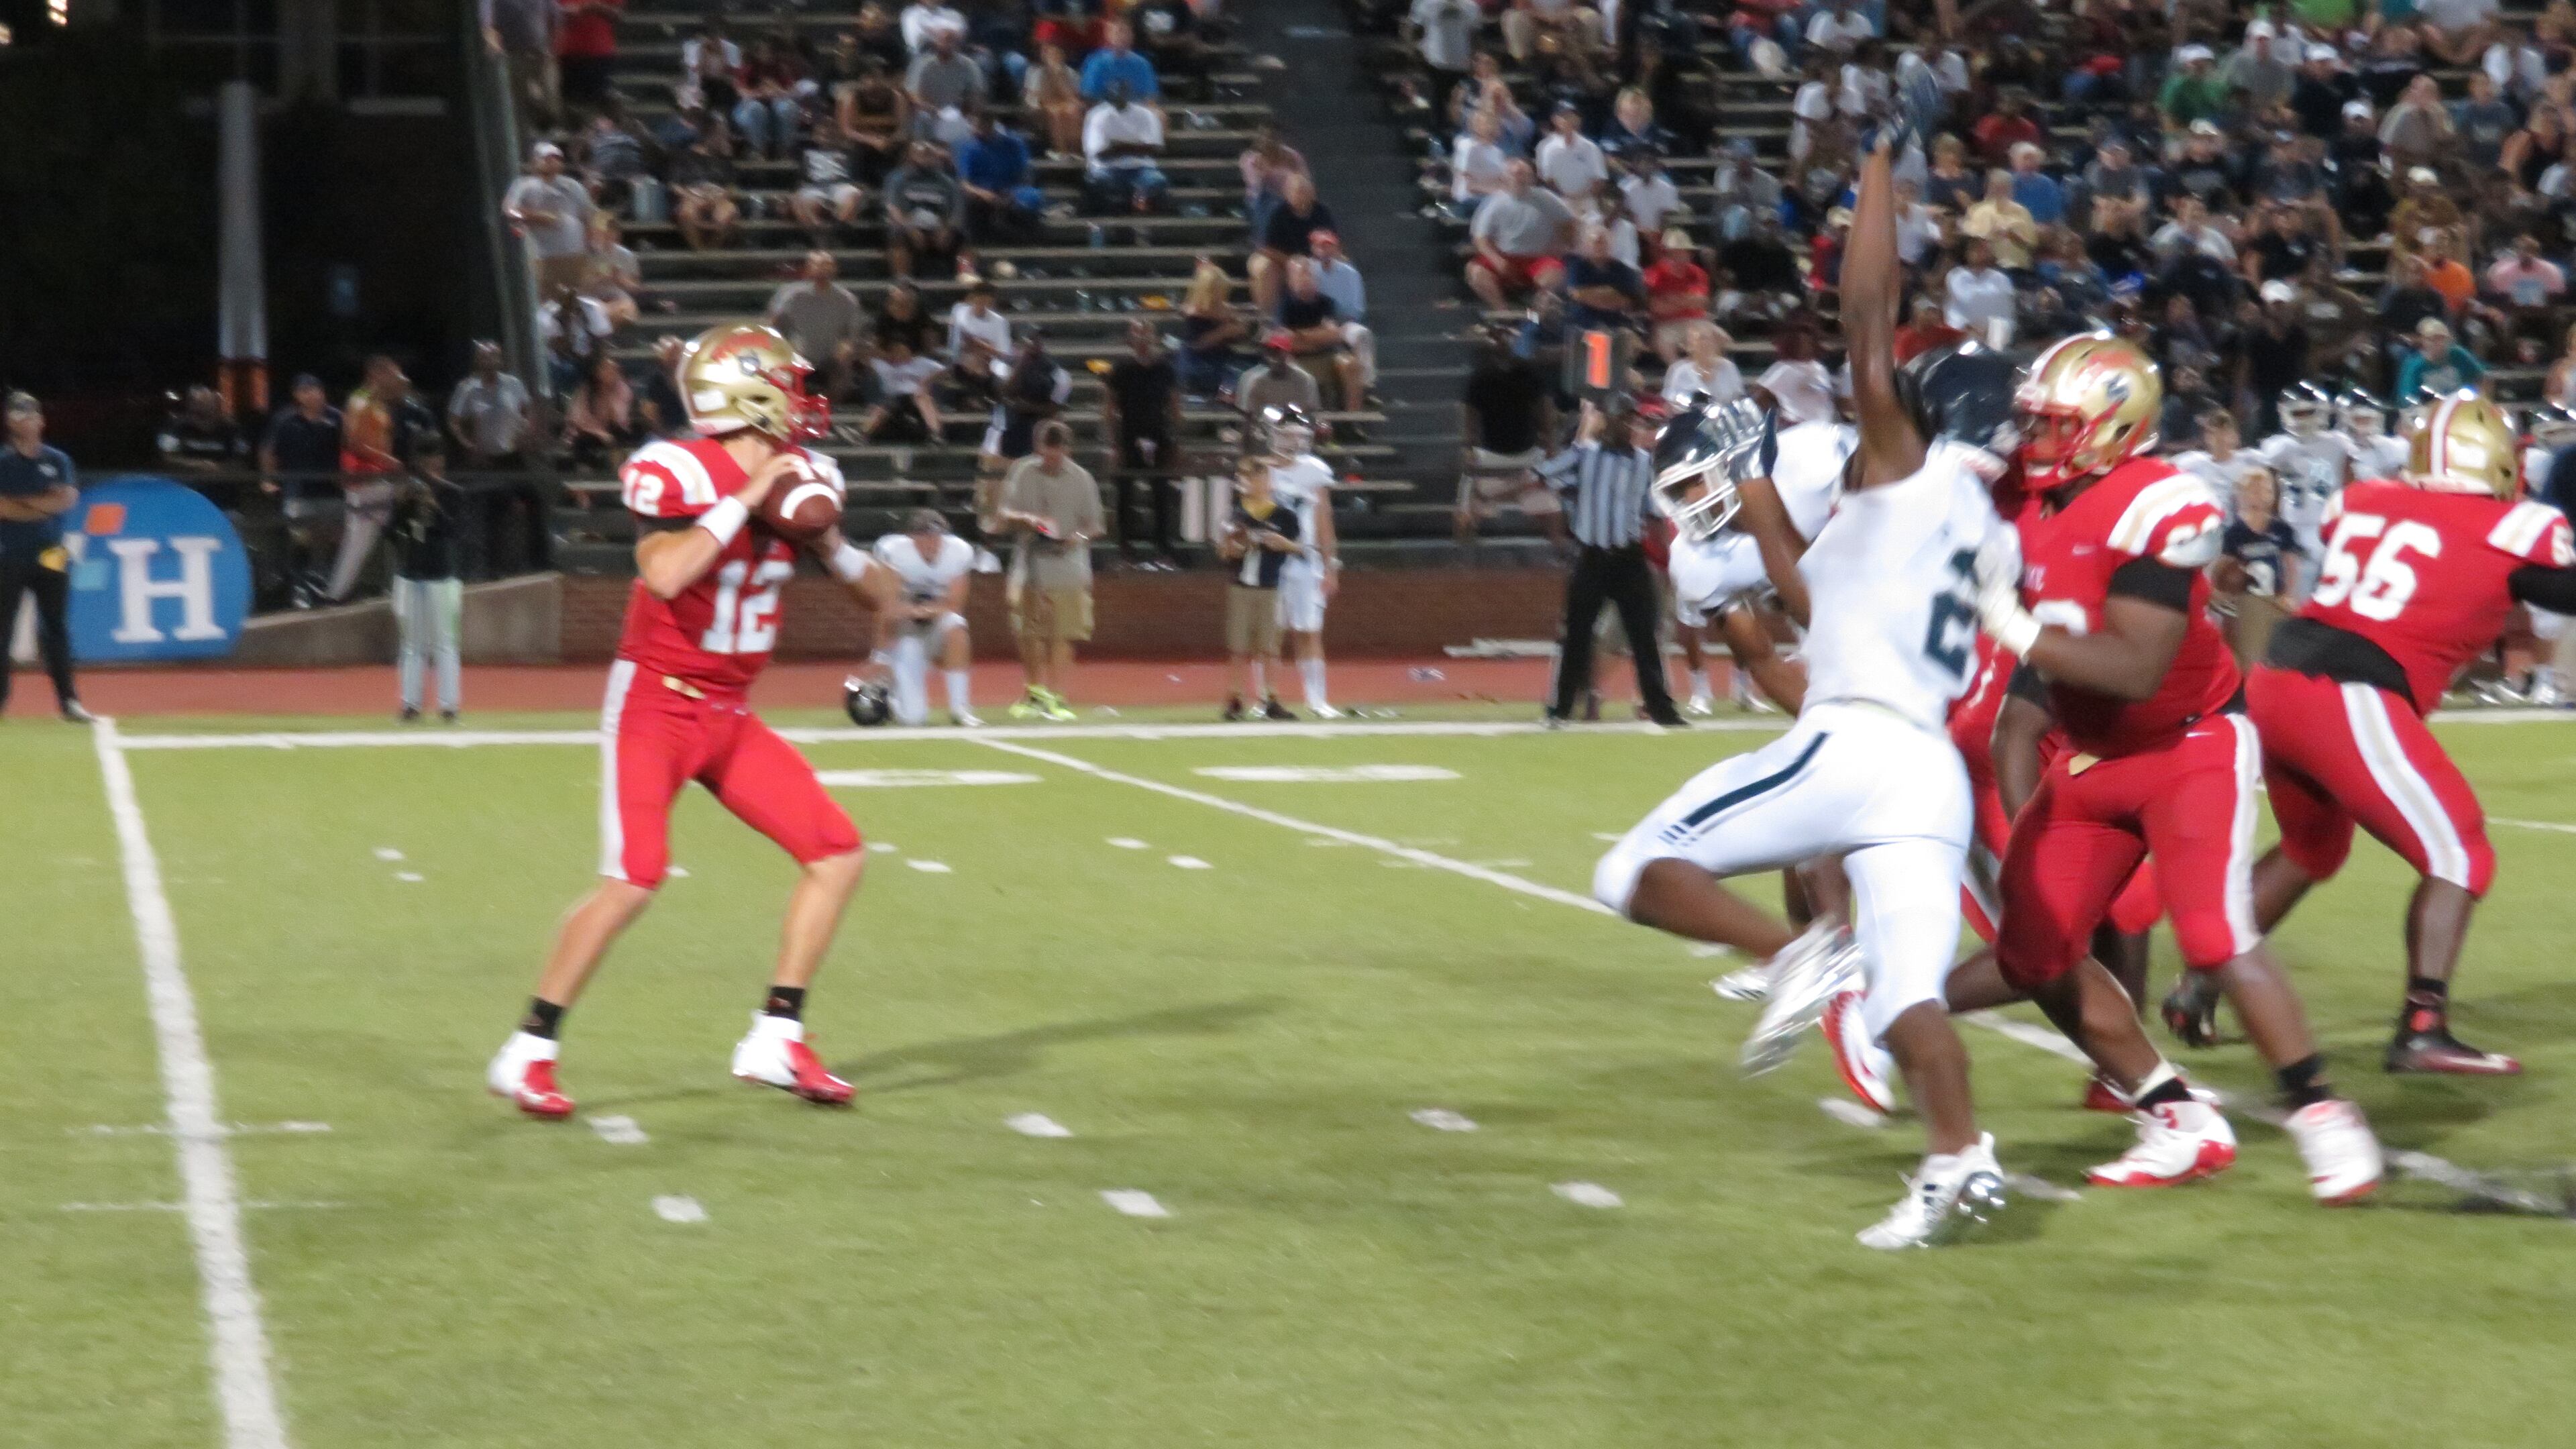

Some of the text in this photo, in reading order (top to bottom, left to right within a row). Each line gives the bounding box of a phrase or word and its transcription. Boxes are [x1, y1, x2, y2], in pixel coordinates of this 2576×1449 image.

[624, 468, 664, 516] 12
[112, 538, 228, 642] H
[700, 560, 796, 654] 12
[2312, 512, 2443, 621] 56
